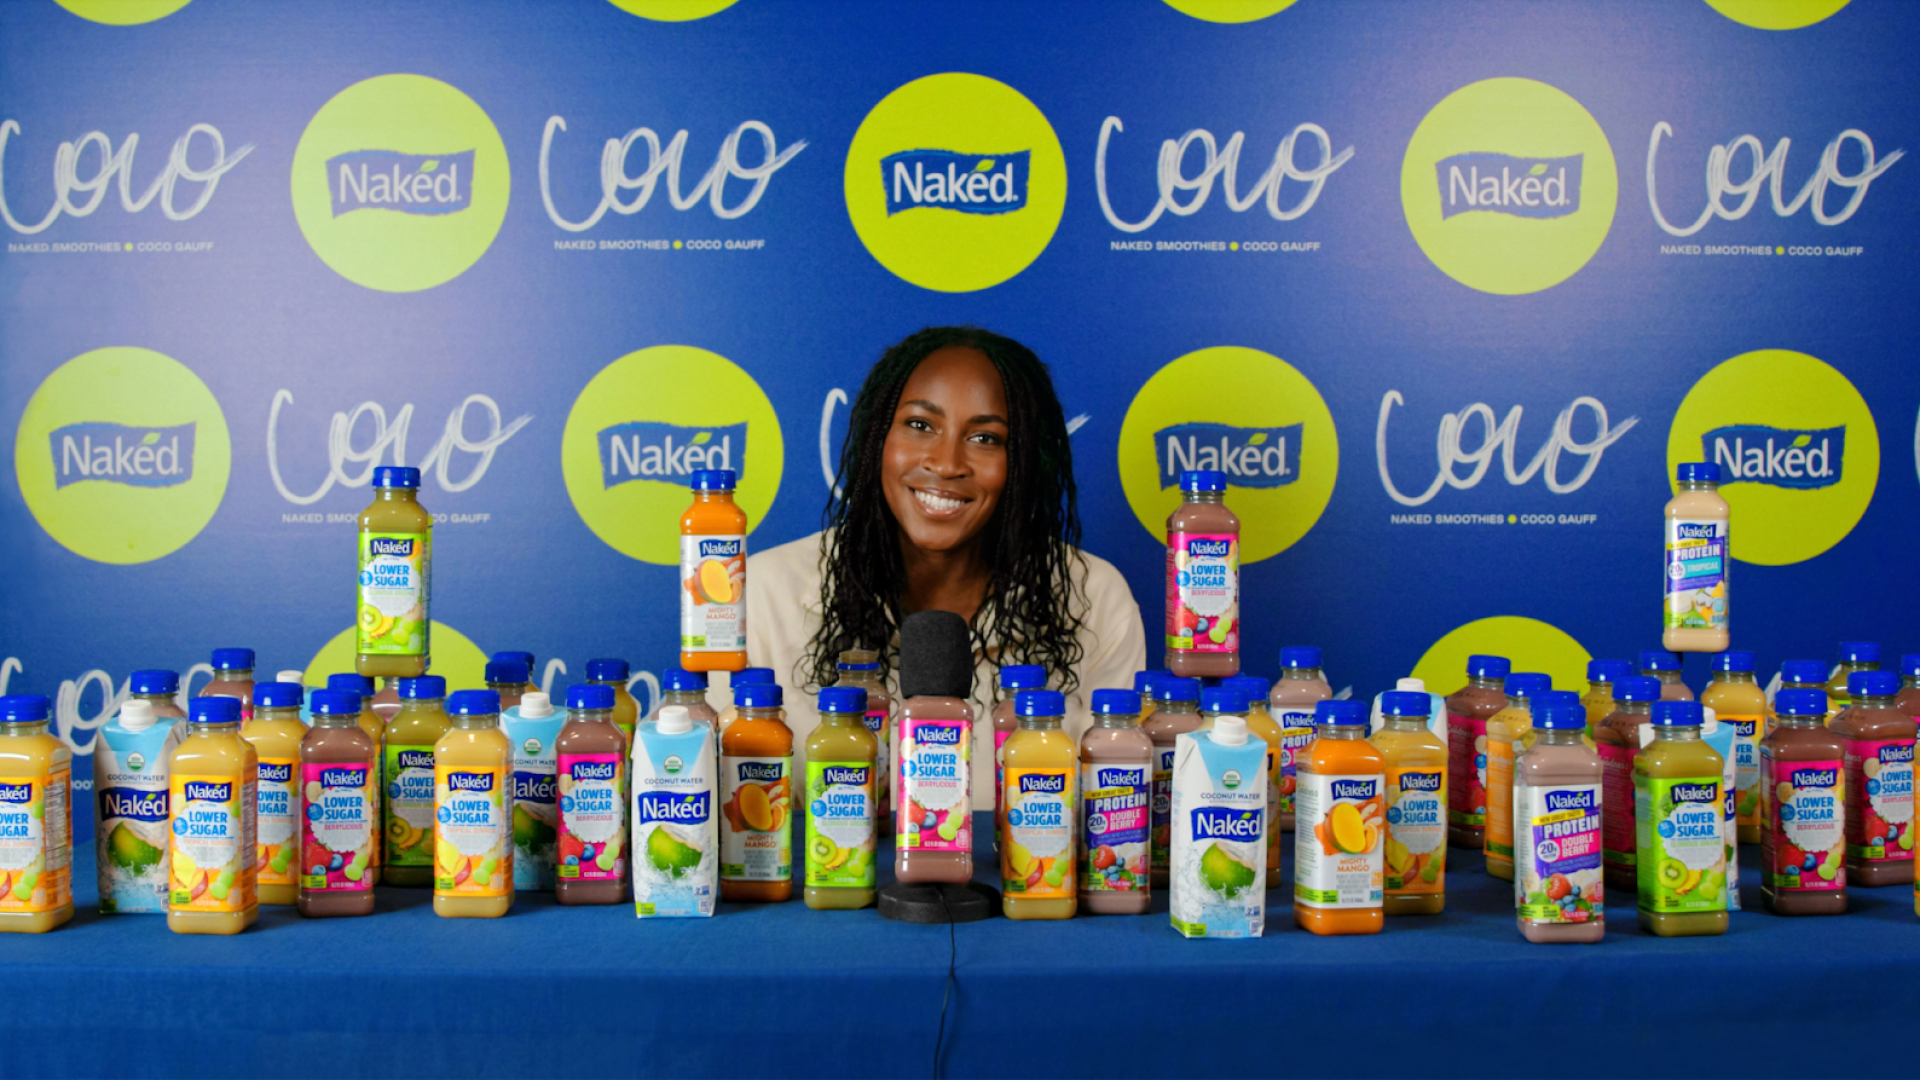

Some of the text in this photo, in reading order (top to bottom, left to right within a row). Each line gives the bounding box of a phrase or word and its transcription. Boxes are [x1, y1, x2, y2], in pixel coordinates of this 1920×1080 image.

[539, 115, 809, 231] Coco
[1095, 115, 1354, 232] Coco
[1647, 121, 1907, 237] Coco
[8, 241, 214, 253] NAKED SMOOTHIES COCO GAUFF
[554, 240, 765, 250] NAKED SMOOTHIES COCO GAUFF
[1110, 241, 1321, 251] NAKED SMOOTHIES COCO GAUFF
[1661, 245, 1864, 256] NAKED SMOOTHIES COCO GAUFF
[1376, 389, 1641, 506] Coco
[282, 513, 324, 523] NAKED
[450, 513, 491, 523] GAUFF
[1390, 514, 1597, 525] NAKED SMOOTHIES COCO GAUFF
[1675, 544, 1721, 560] PROTEIN
[374, 565, 410, 575] LOWER
[1191, 565, 1226, 576] LOWER
[1688, 562, 1719, 573] TROPICAL
[374, 576, 409, 587] SUGAR
[1191, 576, 1225, 587] SUGAR
[918, 753, 957, 765] LOWER
[257, 766, 288, 780] aked
[918, 766, 956, 777] SUGAR
[1881, 770, 1912, 782] LOWER
[0, 786, 28, 800] aked
[1882, 782, 1912, 793] SUGAR
[257, 790, 288, 802] OWER
[575, 789, 612, 800] LOWER
[828, 794, 865, 805] LOWER
[324, 797, 363, 808] LOWER
[452, 800, 490, 811] LOWER
[576, 802, 612, 811] SUGAR
[1095, 792, 1147, 812] PROTEIN
[1403, 800, 1438, 811] LOWER
[1796, 797, 1835, 809] LOWER
[258, 803, 288, 814] UGAR
[828, 806, 864, 817] SUGAR
[1023, 803, 1062, 814] LOWER
[189, 811, 228, 823] LOWER
[324, 809, 362, 820] SUGAR
[452, 813, 489, 823] SUGAR
[1024, 815, 1061, 825] SUGAR
[1110, 809, 1141, 822] DOUBLE
[1403, 812, 1437, 823] SUGAR
[1551, 813, 1566, 822] GREAT
[1567, 811, 1582, 819] TASTE
[1676, 812, 1715, 825] LOWER
[1797, 809, 1834, 821] SUGAR
[190, 825, 227, 836] SUGAR
[1110, 820, 1136, 831] BERRY
[1544, 814, 1600, 839] PROTEIN
[1677, 824, 1715, 837] SUGAR
[1561, 833, 1595, 848] DOUBLE
[1561, 844, 1590, 858] BERRY
